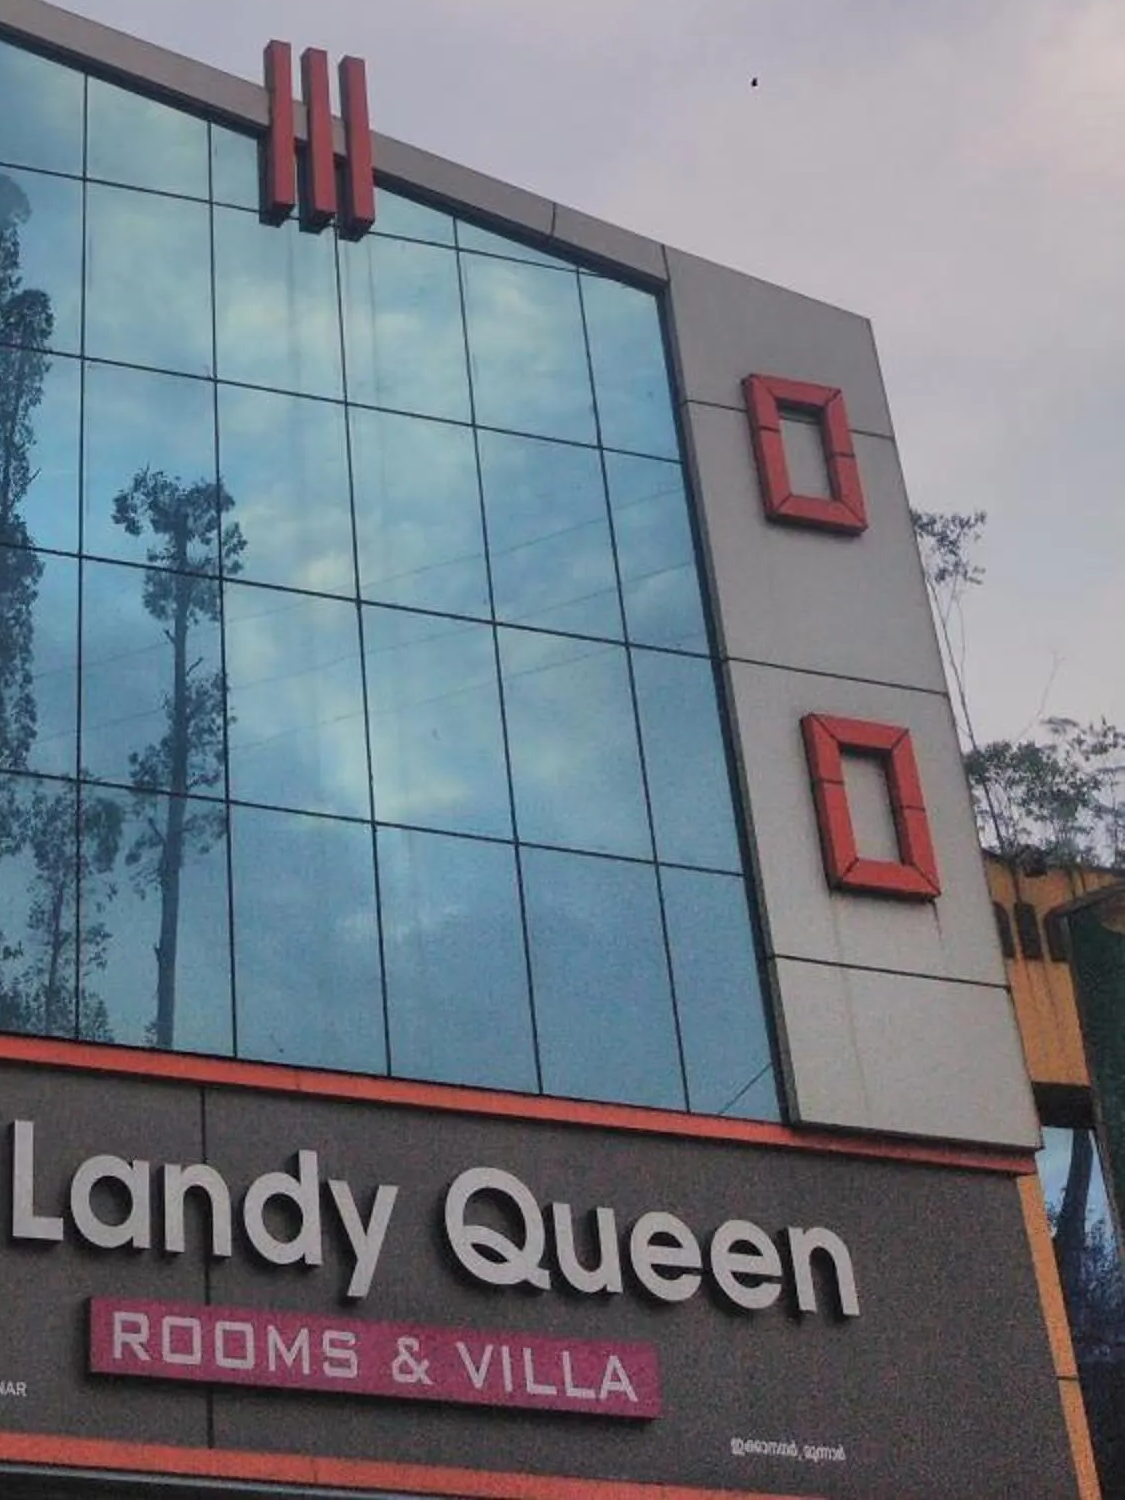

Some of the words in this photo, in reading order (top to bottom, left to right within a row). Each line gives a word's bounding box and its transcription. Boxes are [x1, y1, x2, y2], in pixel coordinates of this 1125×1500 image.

[12, 1119, 399, 1298] Landy
[444, 1166, 861, 1317] Queen
[112, 1311, 359, 1380] ROOMS
[390, 1335, 434, 1386] &
[455, 1340, 639, 1403] VILLA
